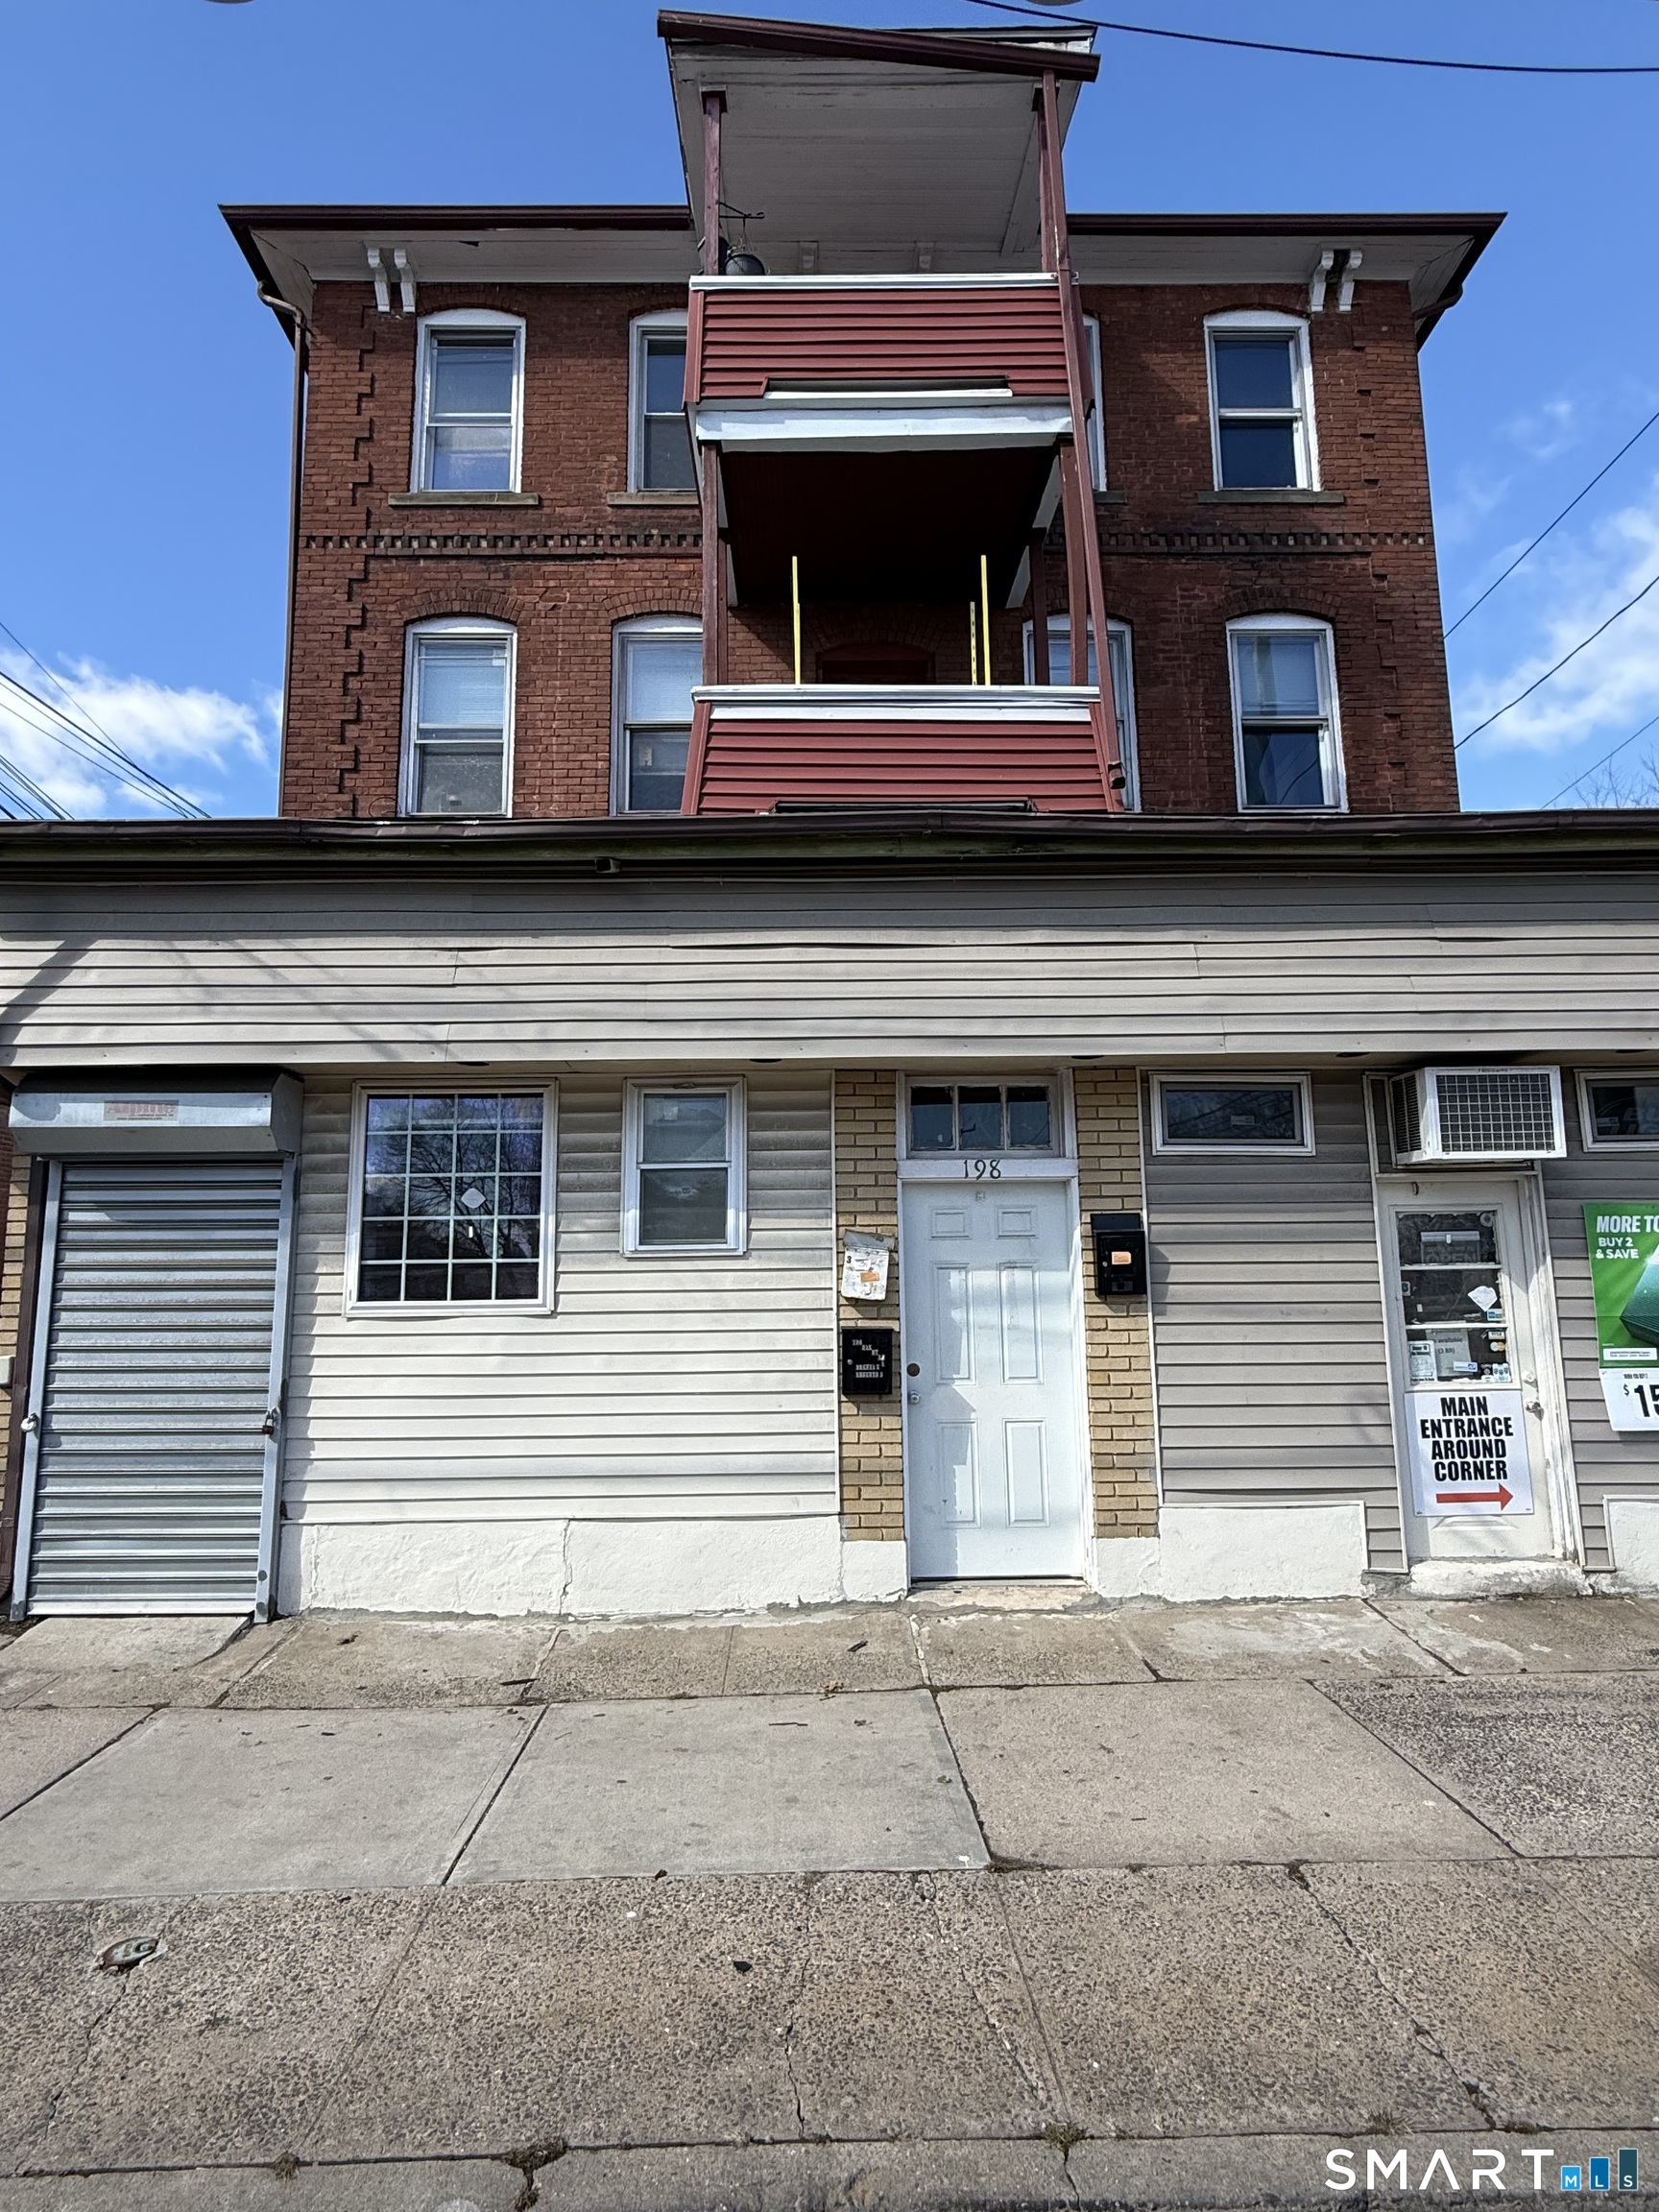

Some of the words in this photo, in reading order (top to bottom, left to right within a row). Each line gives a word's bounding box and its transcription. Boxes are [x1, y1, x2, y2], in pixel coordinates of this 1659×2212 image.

[963, 1159, 1001, 1181] 198
[1597, 1215, 1641, 1234] MORE
[1598, 1237, 1623, 1247] BUY
[1624, 1237, 1634, 1247] 2
[846, 1255, 853, 1264] 3
[1596, 1248, 1604, 1259] &
[1605, 1248, 1640, 1259] SAVE
[1440, 1396, 1489, 1417] MAIN
[1420, 1417, 1514, 1438] ENTRANCE
[1431, 1438, 1507, 1460] AROUND
[1433, 1460, 1508, 1482] CORNER
